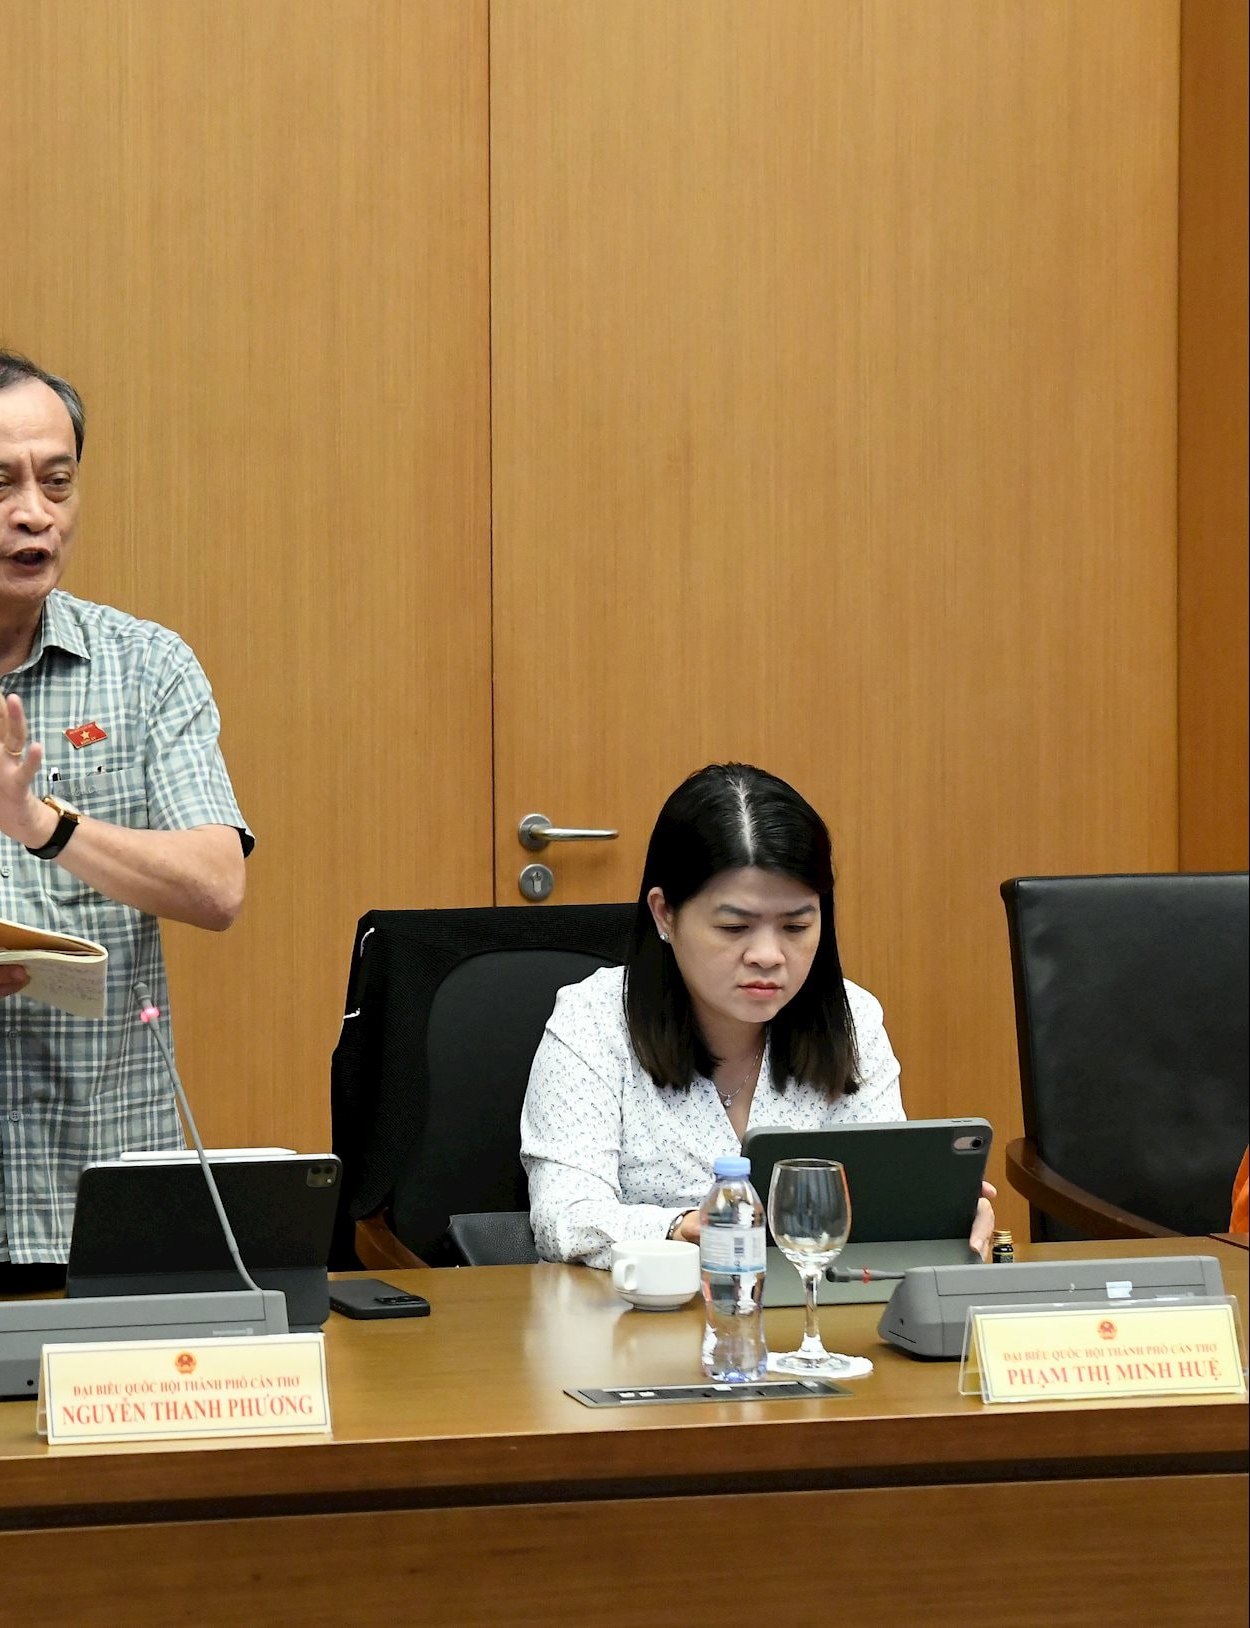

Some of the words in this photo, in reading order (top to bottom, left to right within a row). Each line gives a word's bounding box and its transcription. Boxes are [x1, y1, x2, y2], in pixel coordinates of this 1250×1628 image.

[1007, 1367, 1068, 1389] PHẠM
[1073, 1364, 1110, 1385] THỊ
[1116, 1362, 1172, 1381] MINH
[1178, 1357, 1222, 1381] HUỆ
[62, 1398, 146, 1426] NGUYỄN
[151, 1400, 221, 1421] THANH
[228, 1393, 313, 1418] PHƯƠNG
